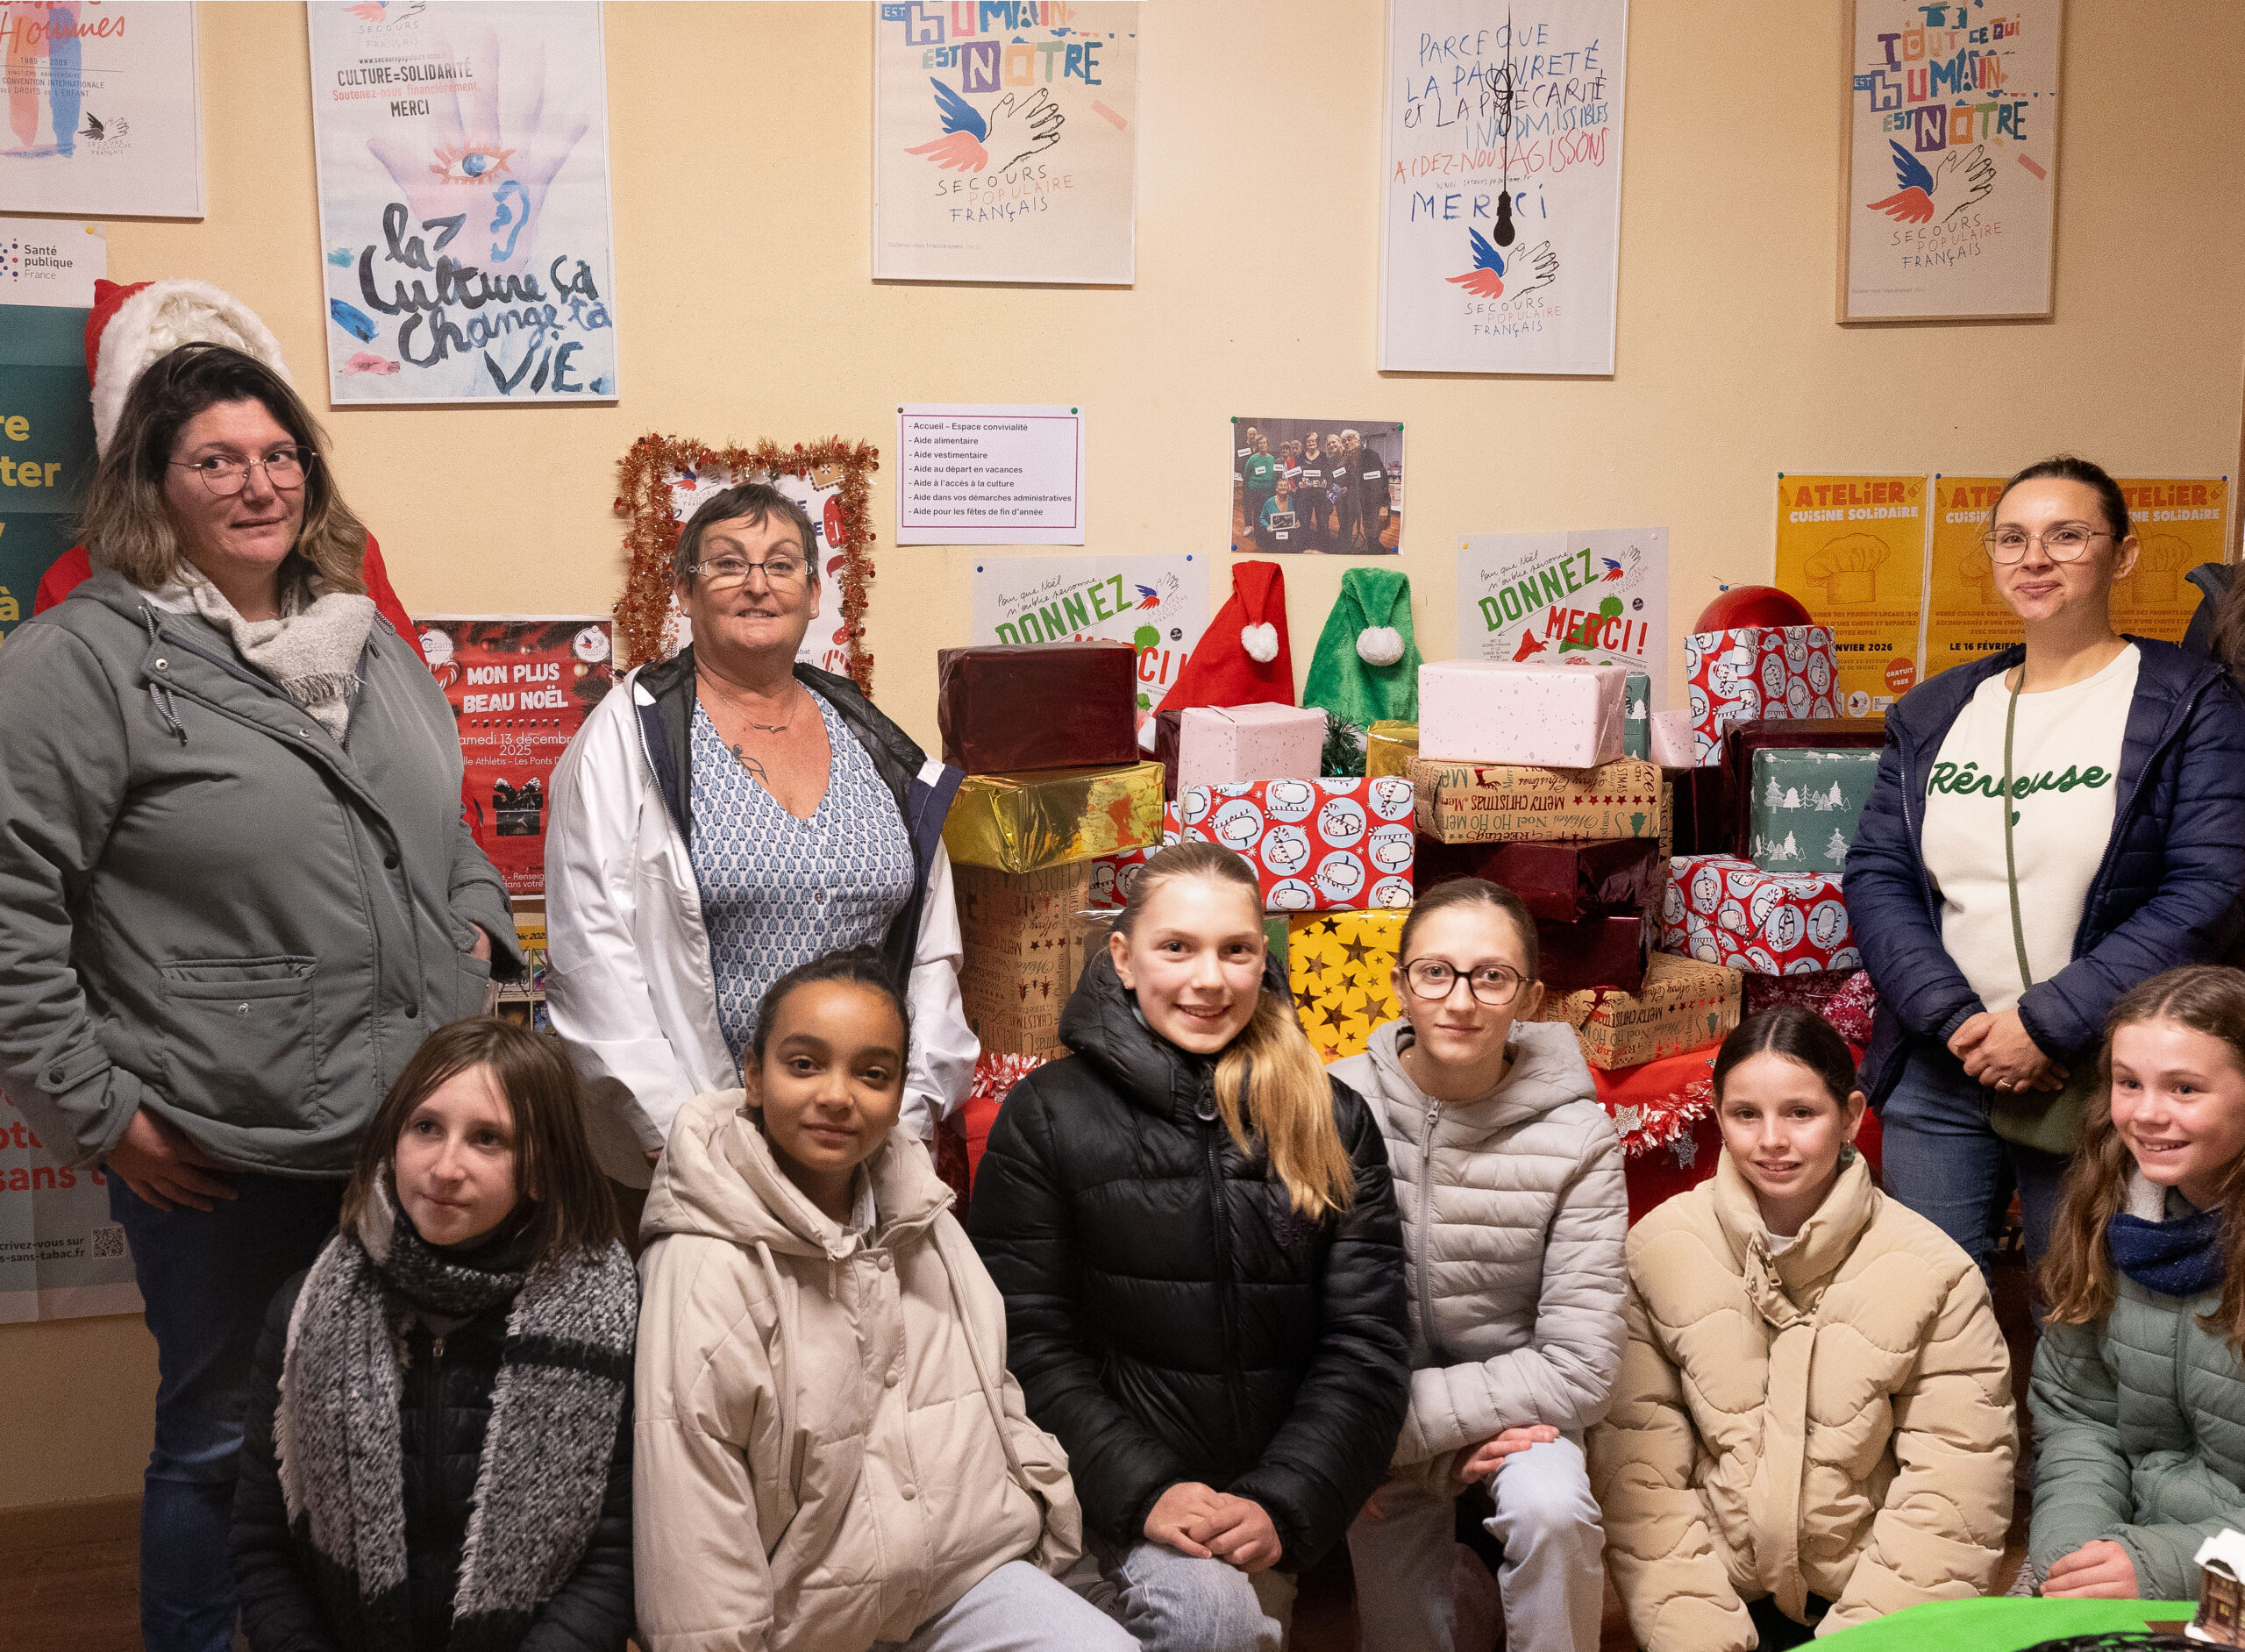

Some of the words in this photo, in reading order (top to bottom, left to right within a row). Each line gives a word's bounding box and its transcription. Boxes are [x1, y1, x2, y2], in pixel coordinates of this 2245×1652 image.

[884, 6, 905, 18] EST
[358, 20, 419, 34] SECOURS
[922, 44, 962, 69] EST
[337, 58, 473, 87] CULTURE=SOLIDARITÉ
[3, 77, 45, 86] CONVENTION
[48, 80, 104, 89] INTERNATIONALE
[1407, 75, 1440, 103] LA
[14, 87, 41, 96] DROITS
[54, 89, 89, 97] L'ENFANT
[390, 99, 430, 117] MERCI
[1436, 96, 1472, 128] LA
[1883, 109, 1914, 133] EST
[935, 164, 1047, 196] SECOURS
[968, 174, 1074, 206] POPULAIRE
[950, 196, 1048, 222] FRANÇAIS
[1891, 213, 1982, 246] SECOURS
[1917, 221, 2003, 253] POPULAIRE
[24, 244, 58, 256] Santé
[1902, 242, 1982, 269] FRANÇAIS
[25, 257, 74, 269] publique
[25, 270, 57, 280] France
[1464, 296, 1544, 315] SECOURS
[1487, 305, 1563, 324] POPULAIRE
[1473, 320, 1543, 338] FRANÇAIS
[951, 423, 981, 432] Espace
[945, 465, 972, 475] départ
[940, 479, 969, 488] l'accès
[1480, 568, 1499, 582] Pour
[1500, 562, 1518, 576] que
[1520, 549, 1539, 566] Noël
[998, 593, 1018, 607] Pour
[1020, 588, 1038, 601] que
[1041, 574, 1061, 591] Noël
[1478, 547, 1600, 632] DONNEZ
[994, 573, 1133, 645] DONNEZ
[1545, 605, 1633, 652] MERCI
[424, 641, 451, 650] cezam
[1868, 643, 1893, 652] 2026
[1949, 642, 1962, 651] LE
[1963, 642, 1974, 651] 16
[467, 665, 508, 686] MON
[513, 662, 560, 683] PLUS
[1885, 667, 1914, 678] GRATUIT
[1892, 678, 1909, 687] FREE
[463, 692, 515, 714] BEAU
[520, 685, 569, 710] NOËL
[459, 731, 496, 745] amedi
[500, 733, 513, 744] 13
[516, 730, 573, 745] décembr
[499, 744, 531, 756] 2025
[474, 755, 507, 765] Athlétis
[514, 756, 528, 765] Les
[530, 755, 553, 765] Ponts
[1471, 814, 1489, 830] HO
[1493, 814, 1512, 830] HO
[1517, 816, 1547, 828] Noel
[1008, 1015, 1053, 1029] CHRISTMAS
[67, 1236, 85, 1246] sur
